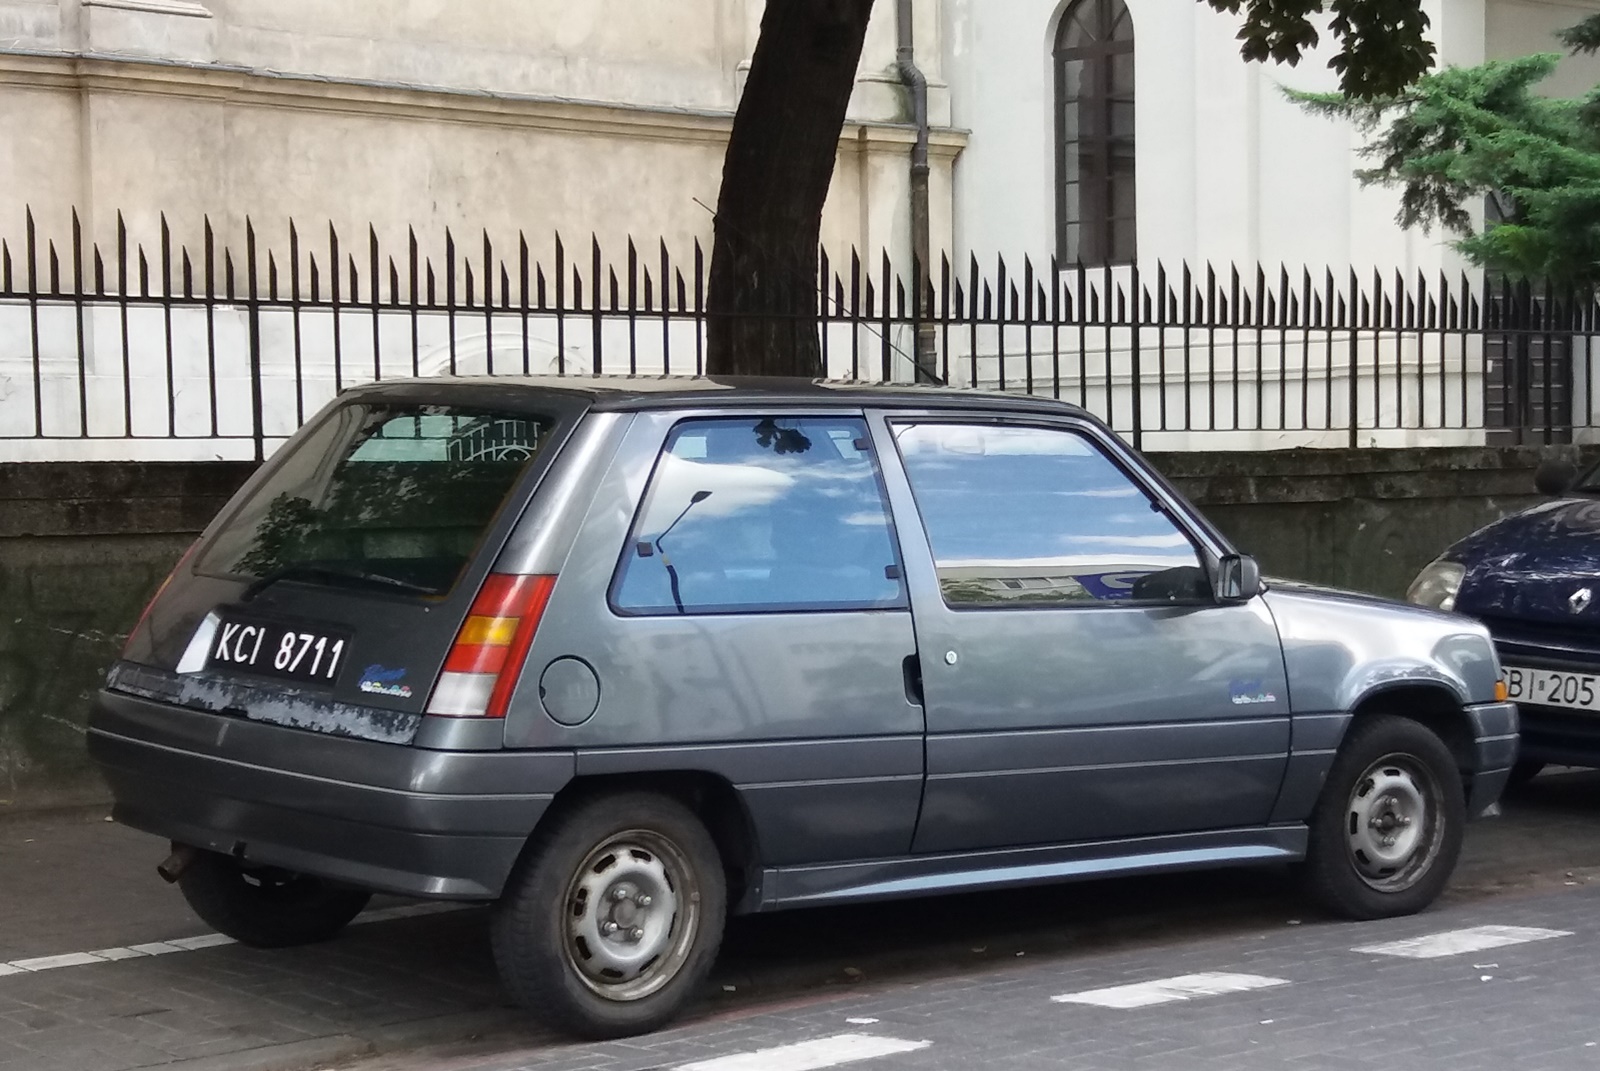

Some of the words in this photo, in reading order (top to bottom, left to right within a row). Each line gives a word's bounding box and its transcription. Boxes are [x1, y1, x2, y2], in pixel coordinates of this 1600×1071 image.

[215, 622, 266, 665] KCI
[274, 631, 344, 679] 8711
[1501, 668, 1534, 700] BI
[1547, 674, 1600, 706] 205
